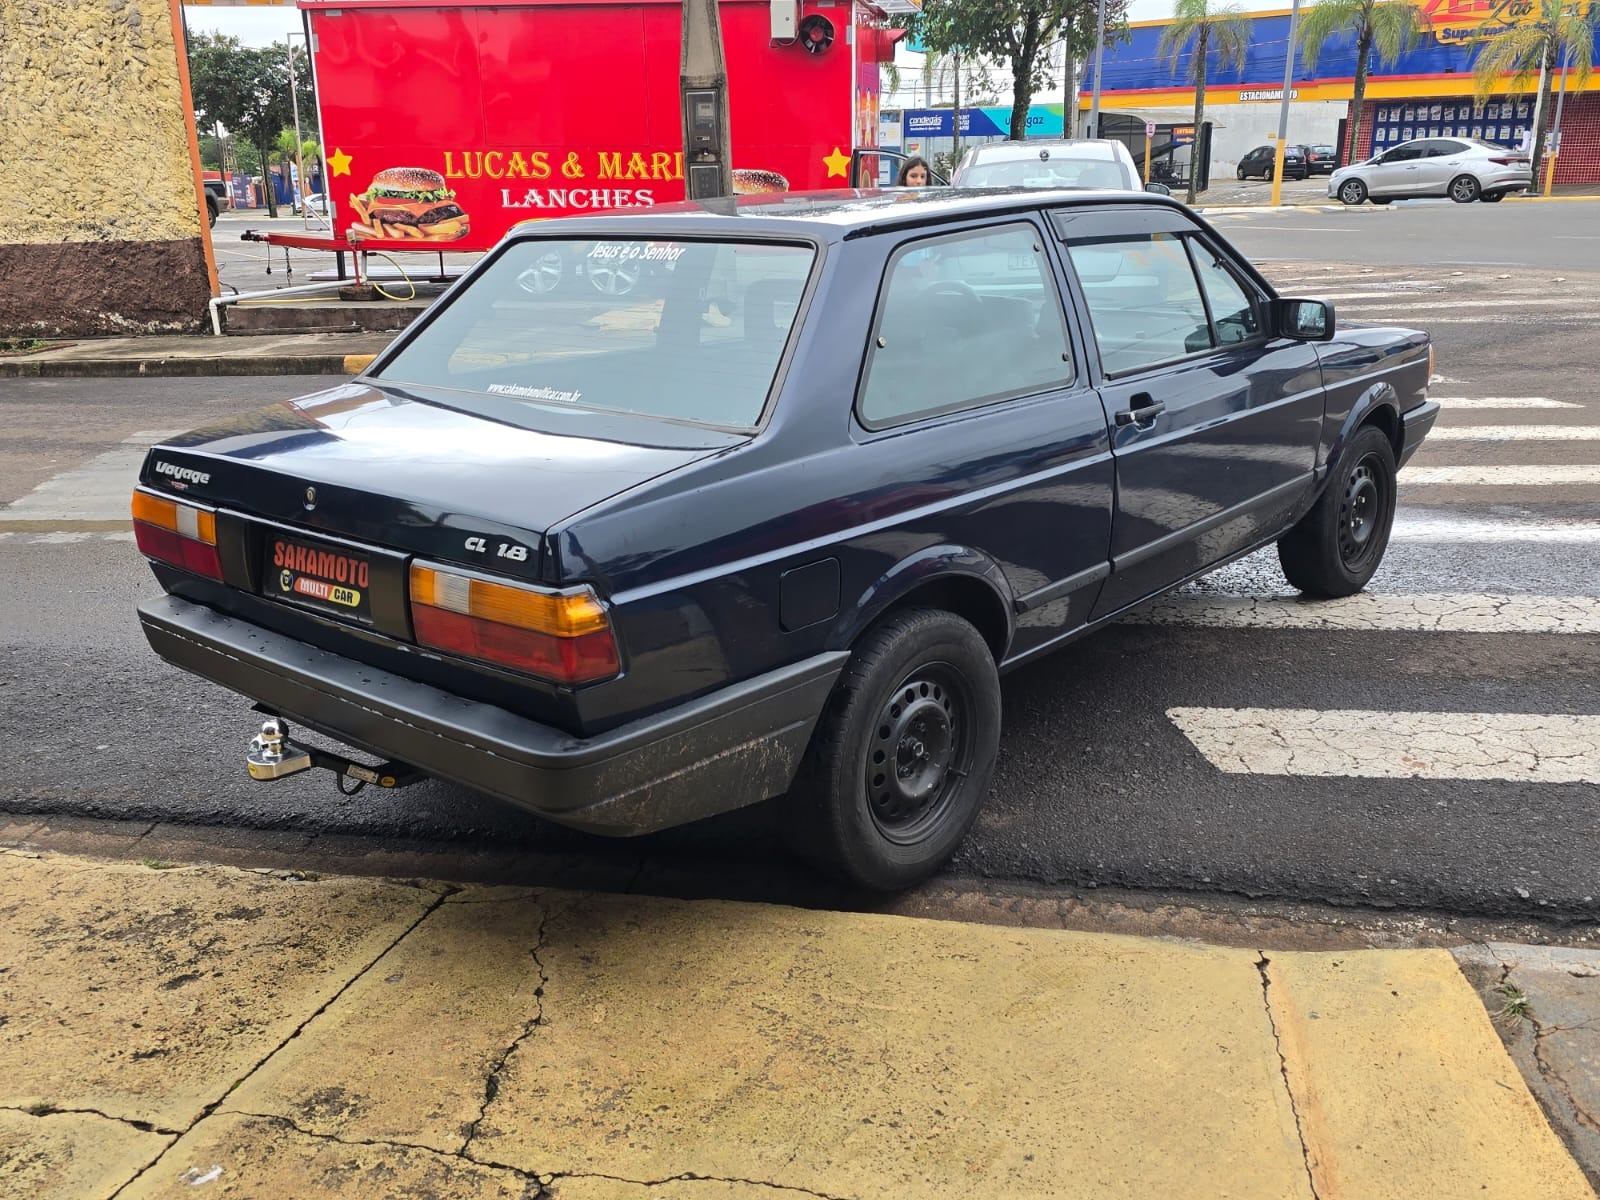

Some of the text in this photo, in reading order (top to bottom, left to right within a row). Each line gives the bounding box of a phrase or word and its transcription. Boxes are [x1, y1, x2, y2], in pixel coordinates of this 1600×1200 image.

[1240, 89, 1298, 101] ESTACIONAMETO
[1005, 116, 1045, 128] ugaz
[444, 151, 550, 179] LUCAS
[561, 151, 585, 179] &
[500, 188, 655, 209] LANCHES
[587, 241, 686, 261] Jesus é o Senhor
[464, 536, 487, 553] CL
[274, 541, 369, 588] SAKAMOTO
[300, 579, 354, 604] MULTI CAR
